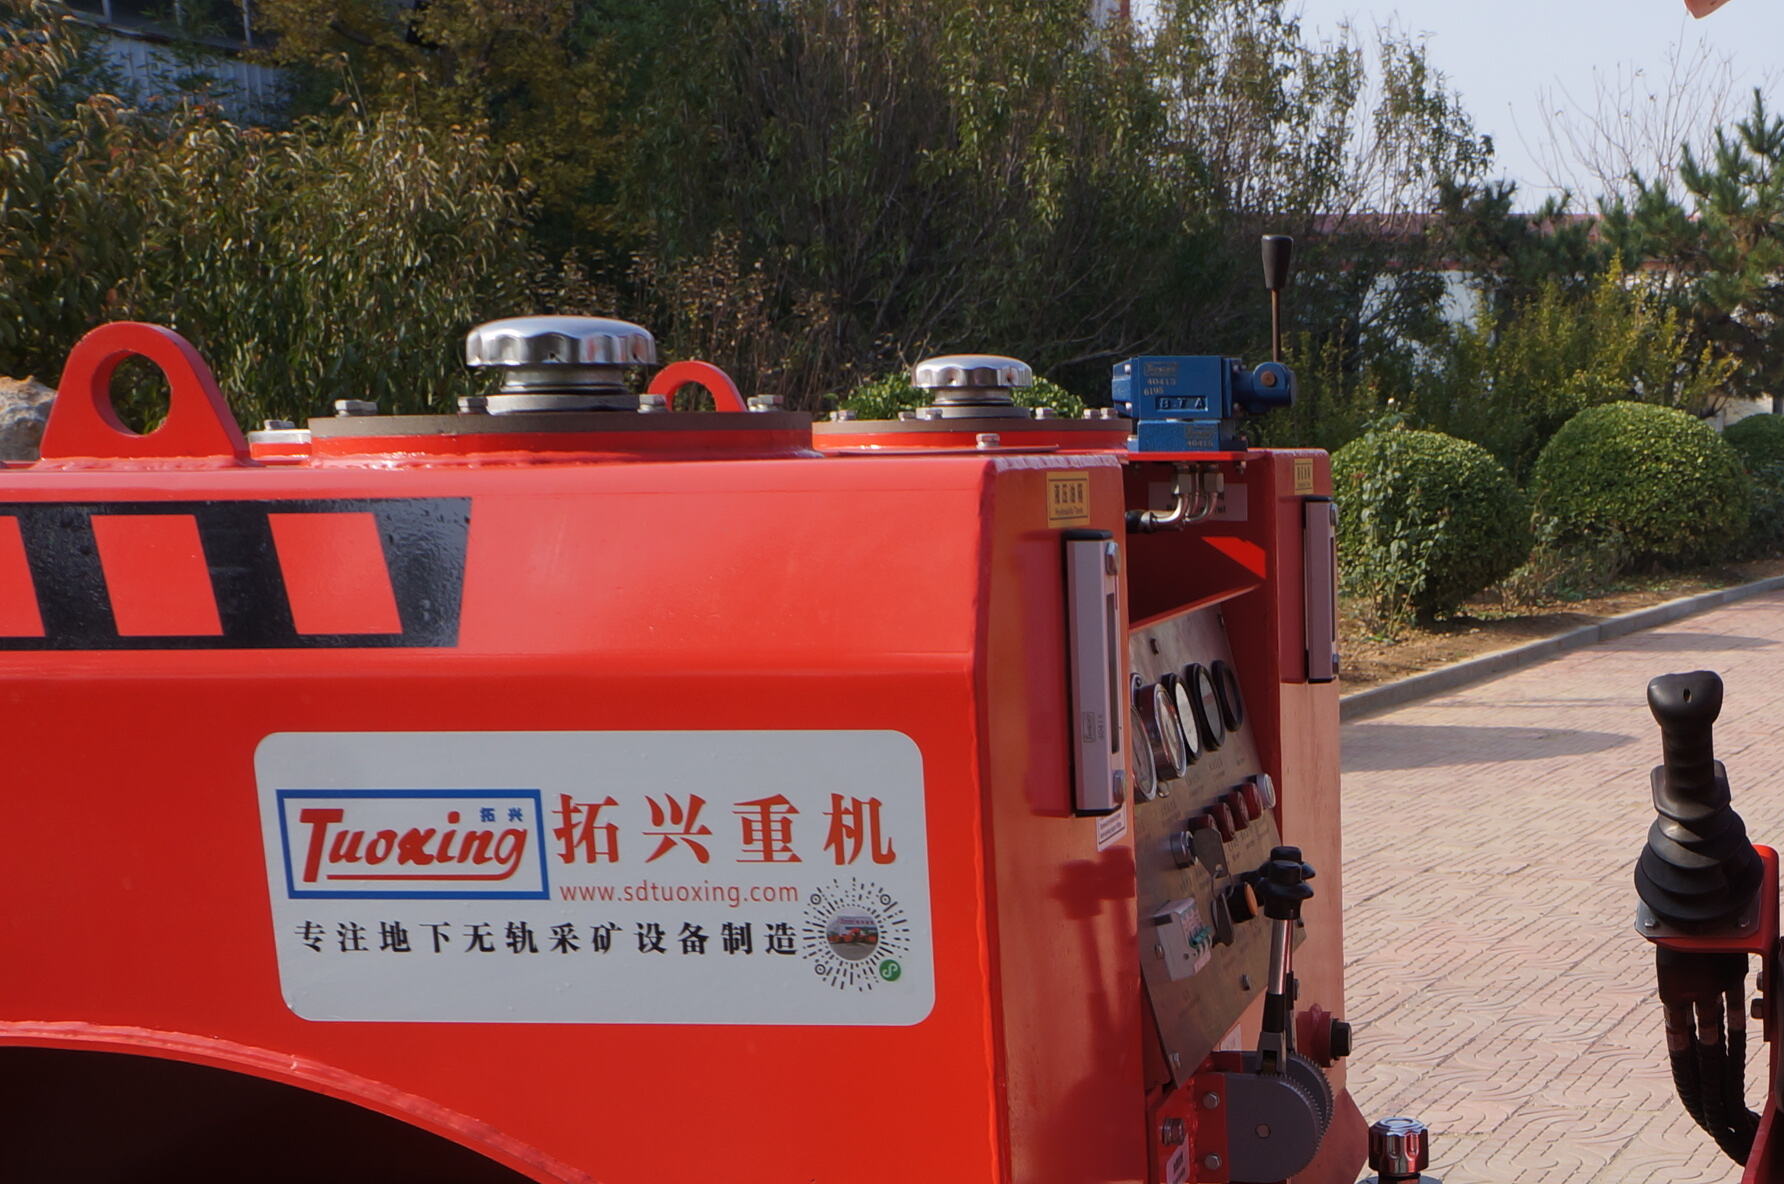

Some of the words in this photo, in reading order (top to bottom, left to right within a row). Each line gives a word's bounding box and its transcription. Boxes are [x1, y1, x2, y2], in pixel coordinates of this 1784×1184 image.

[479, 807, 523, 822] 拓兴
[551, 793, 897, 866] 拓兴重机
[299, 808, 528, 883] Tuoxing
[559, 880, 799, 908] www.sdtuoxing.com
[294, 919, 798, 955] 专注地下无轨采矿设备制造
